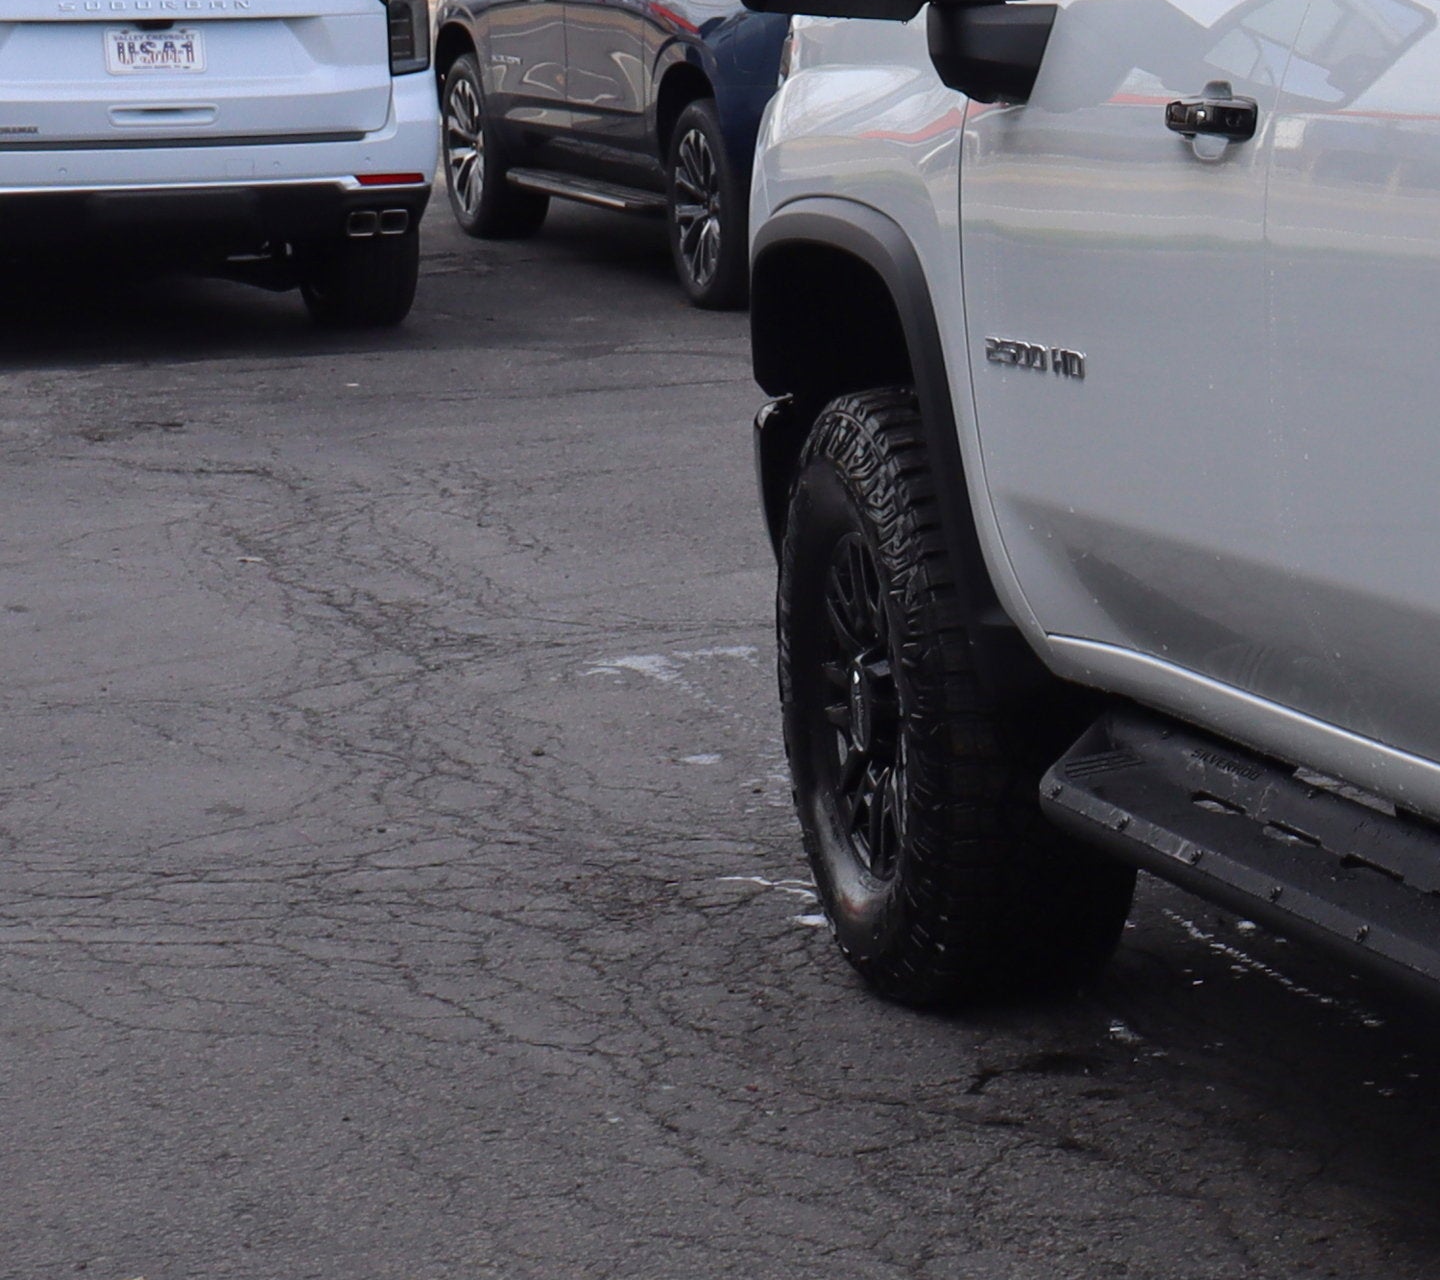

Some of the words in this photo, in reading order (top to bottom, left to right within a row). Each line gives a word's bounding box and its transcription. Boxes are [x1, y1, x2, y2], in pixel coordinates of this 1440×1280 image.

[58, 0, 250, 12] SUBURBAN
[984, 335, 1048, 372] 2500
[1050, 346, 1087, 381] HD
